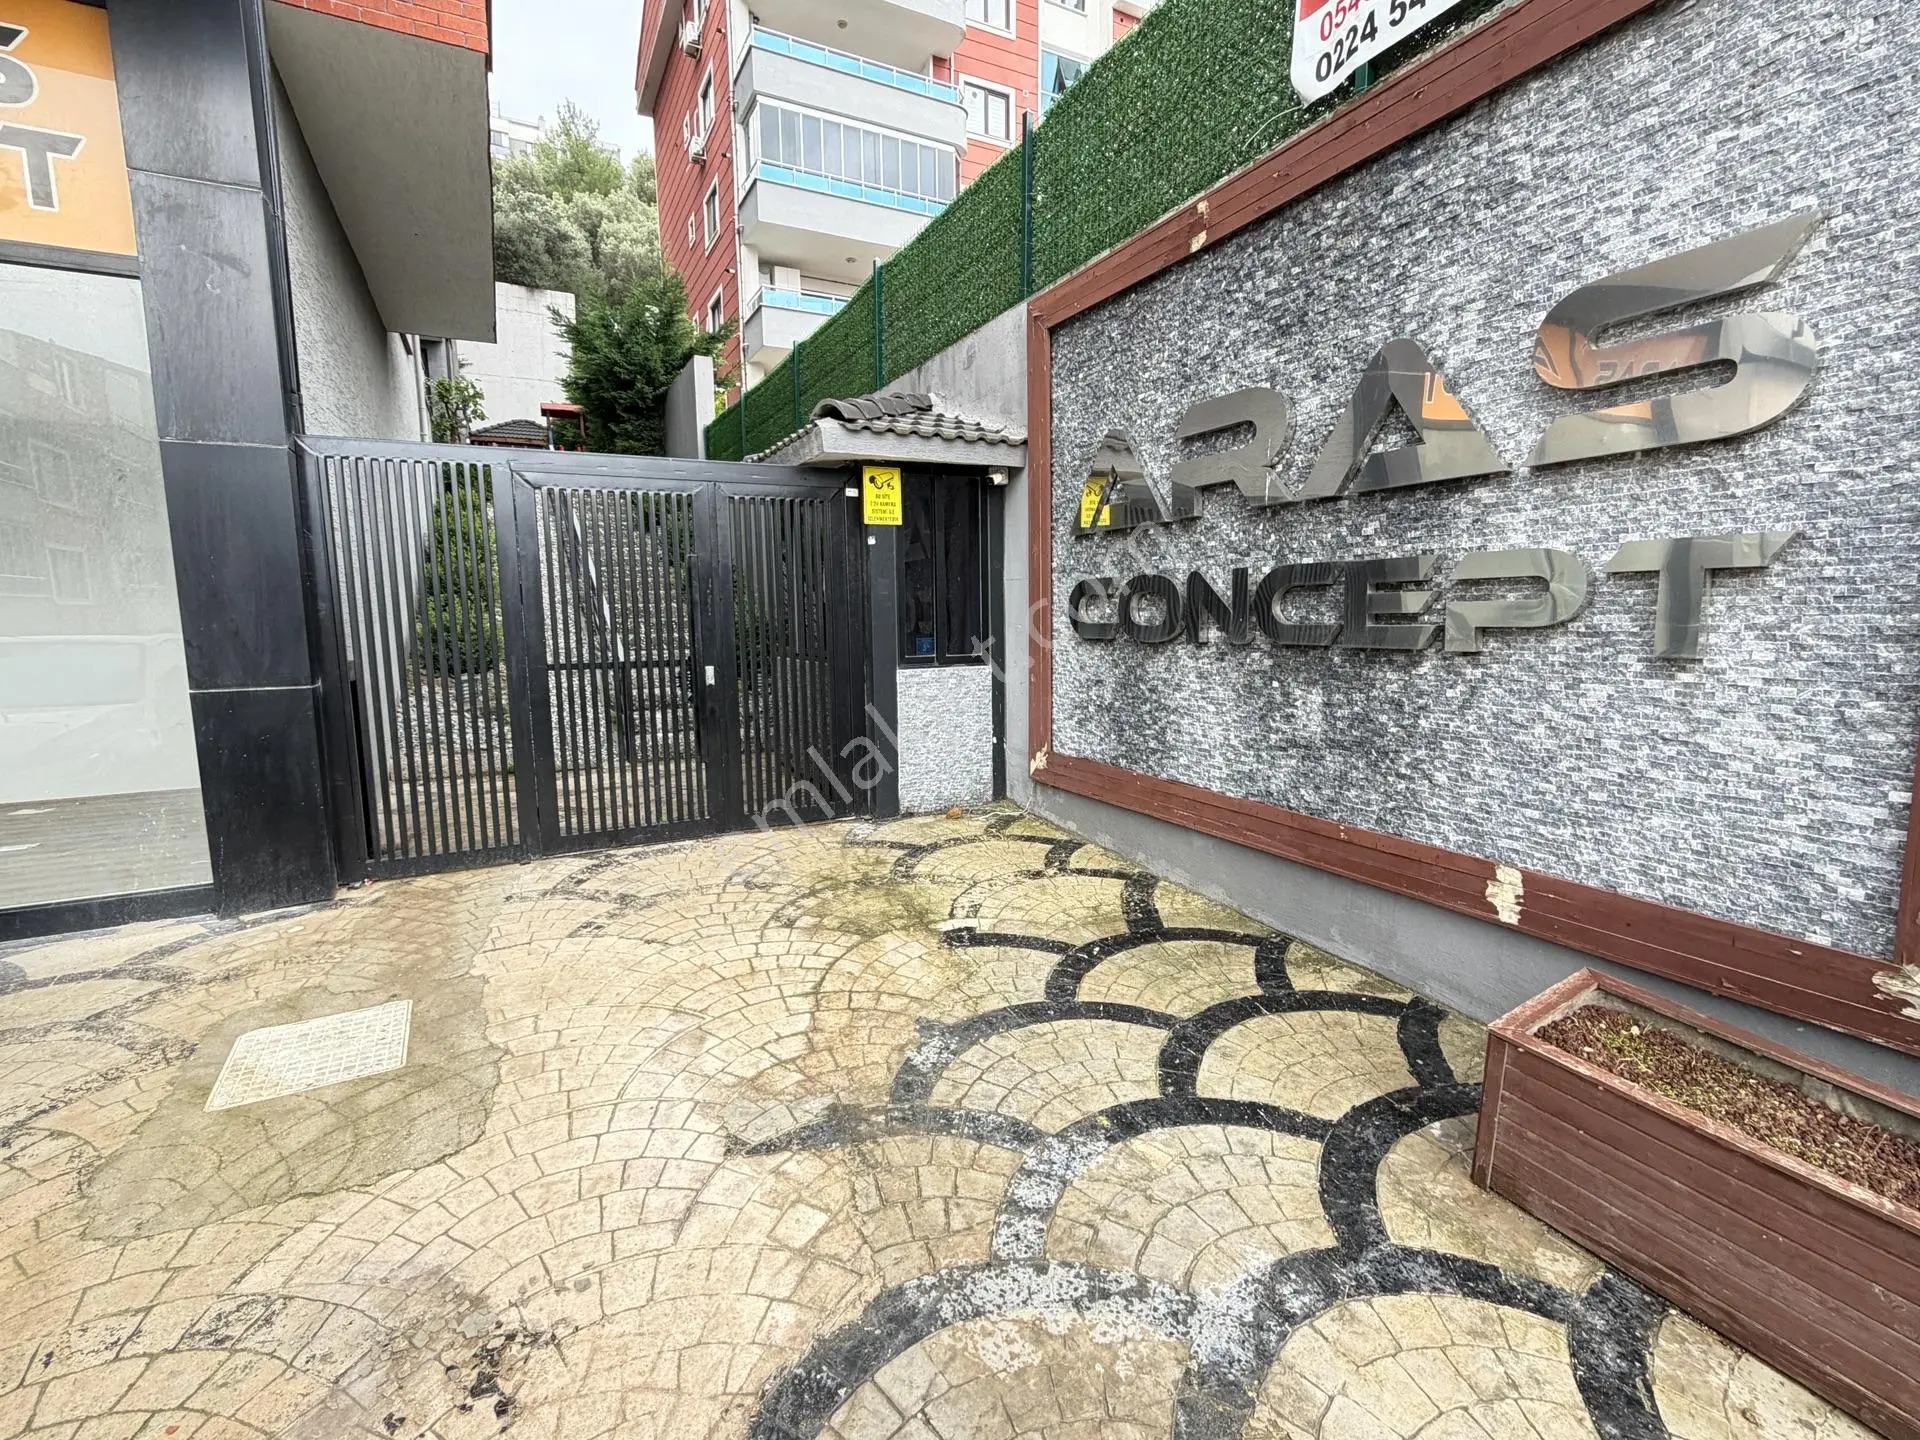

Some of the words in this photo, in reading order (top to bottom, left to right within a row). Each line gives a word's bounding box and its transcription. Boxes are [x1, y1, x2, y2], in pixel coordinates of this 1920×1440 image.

[1315, 9, 1378, 82] 0224
[1072, 208, 1830, 538] ARAS
[1068, 530, 1804, 660] CONCEPT
